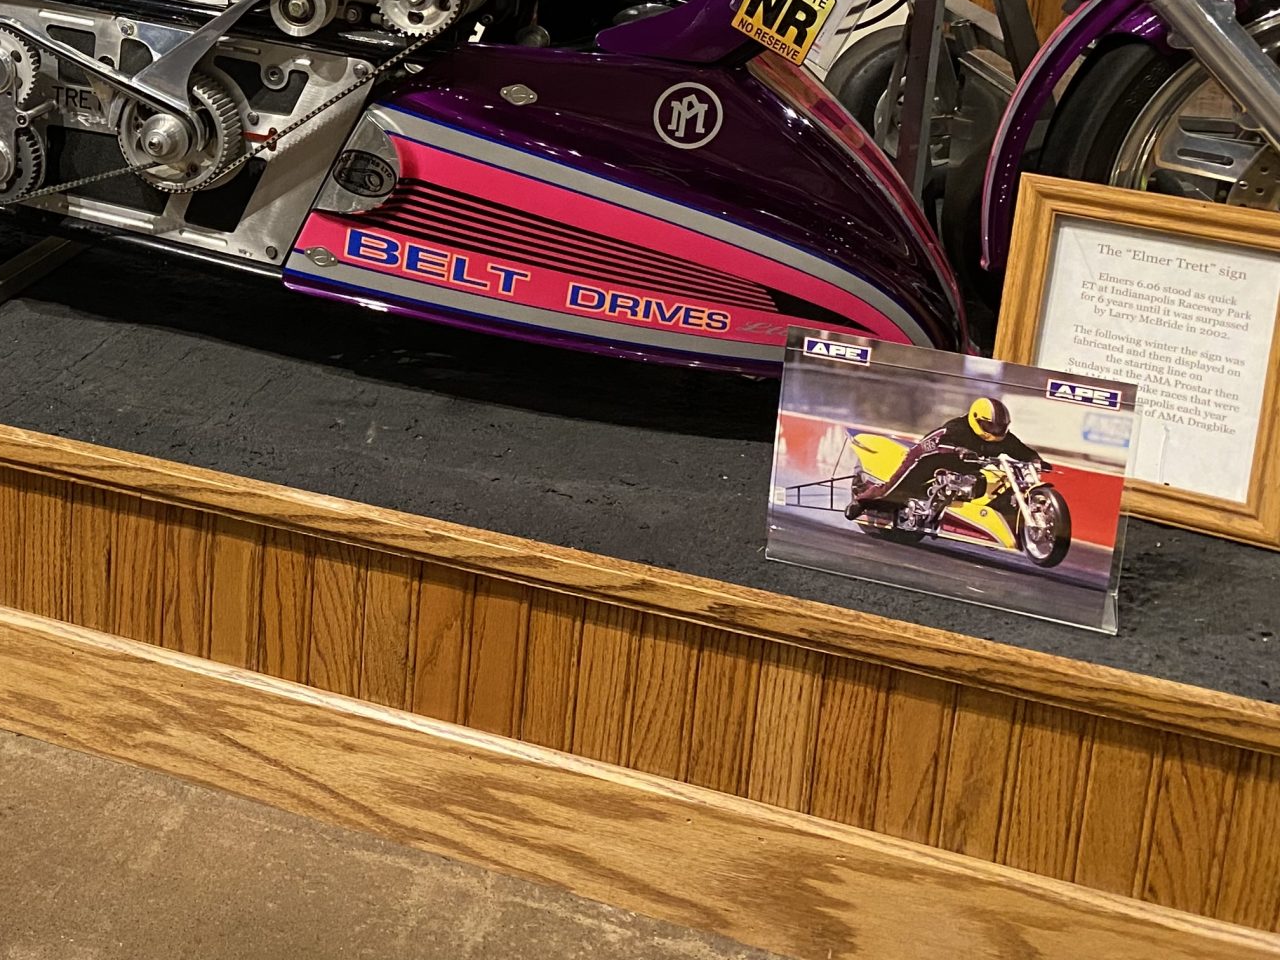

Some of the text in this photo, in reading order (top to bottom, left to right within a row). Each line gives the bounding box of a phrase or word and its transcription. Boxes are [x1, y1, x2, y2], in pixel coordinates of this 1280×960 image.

[738, 18, 800, 60] NO RESERVE
[1097, 243, 1123, 258] The
[1218, 266, 1247, 281] sign
[343, 228, 732, 334] BELT DRIVES
[1098, 272, 1237, 306] Elmers 6.06 stood as quick
[1080, 291, 1249, 332] for 6 years until it was surpassed
[1081, 280, 1252, 321] ET at Indianapolis Raceway Park
[1093, 305, 1231, 340] by Larry McBride in 2002.
[806, 342, 862, 361] APE
[1073, 324, 1245, 366] The following winter the sign was
[1073, 335, 1241, 378] fabricated and then displayed on
[1068, 357, 1239, 401] Sundays at the AMA Prostar then
[1105, 353, 1203, 381] the starting line on
[1054, 384, 1111, 406] APE
[1160, 390, 1240, 413] races that were
[1177, 403, 1228, 422] each year
[1144, 408, 1237, 435] of AMA Dragbike
